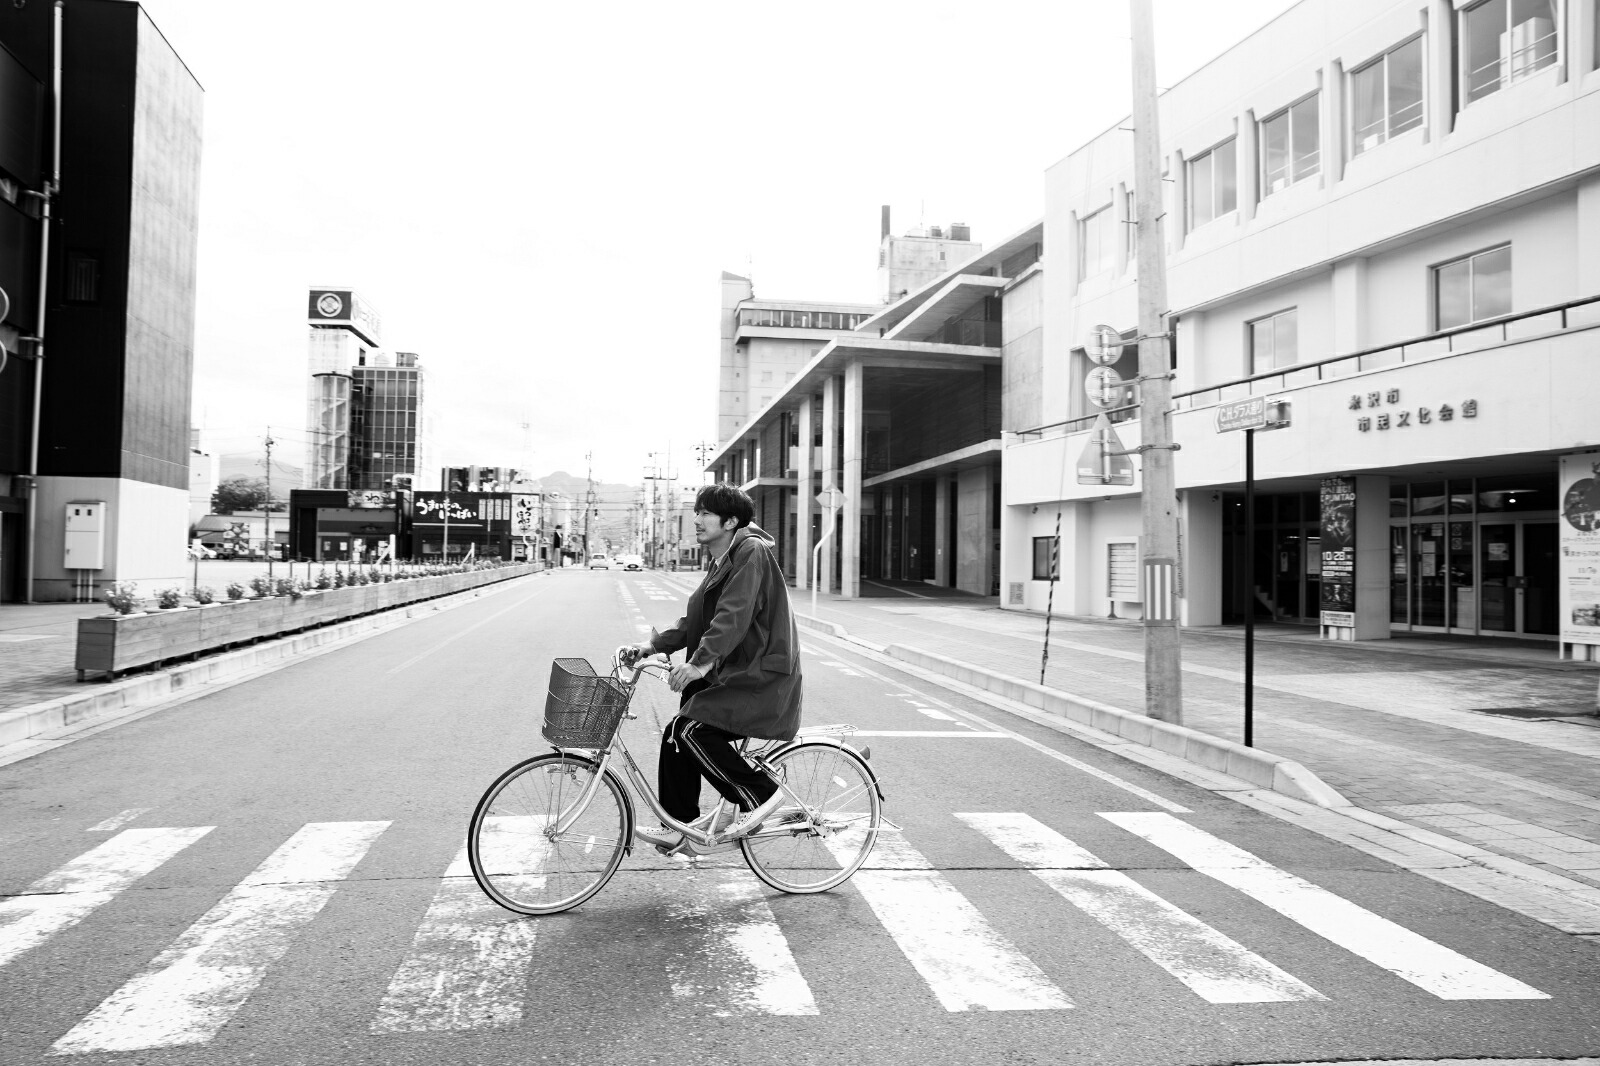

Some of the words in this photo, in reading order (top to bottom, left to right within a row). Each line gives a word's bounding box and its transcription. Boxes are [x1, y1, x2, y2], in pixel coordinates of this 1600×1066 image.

[1349, 388, 1400, 410] 米沢市
[1357, 399, 1478, 432] 市民文化会館
